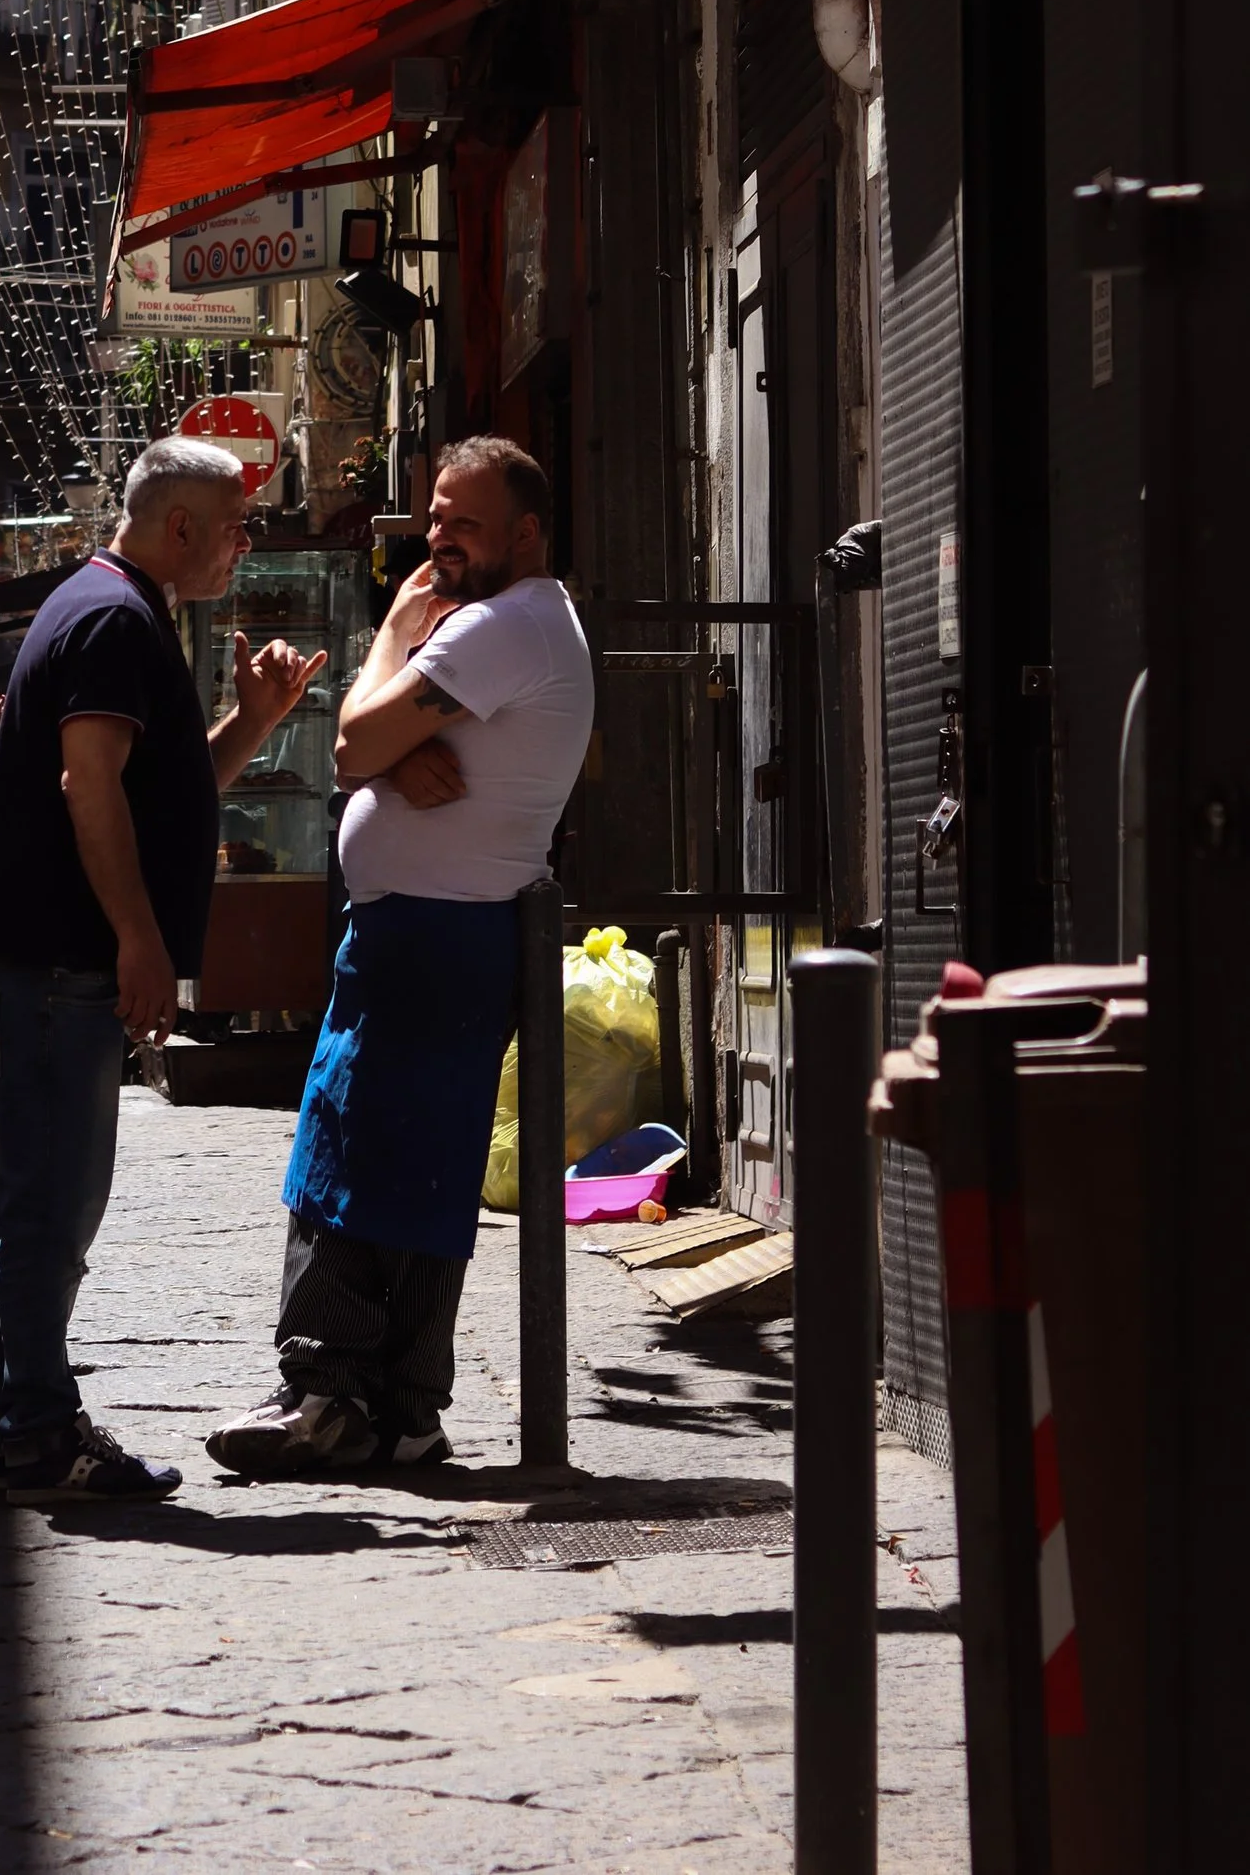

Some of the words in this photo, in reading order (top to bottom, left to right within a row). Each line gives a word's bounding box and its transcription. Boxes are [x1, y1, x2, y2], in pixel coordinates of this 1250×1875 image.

[138, 301, 162, 311] FIORI
[164, 303, 171, 311] &
[173, 303, 236, 313] OGGETTISTICA
[125, 311, 146, 321] Info:
[147, 313, 161, 321] 081
